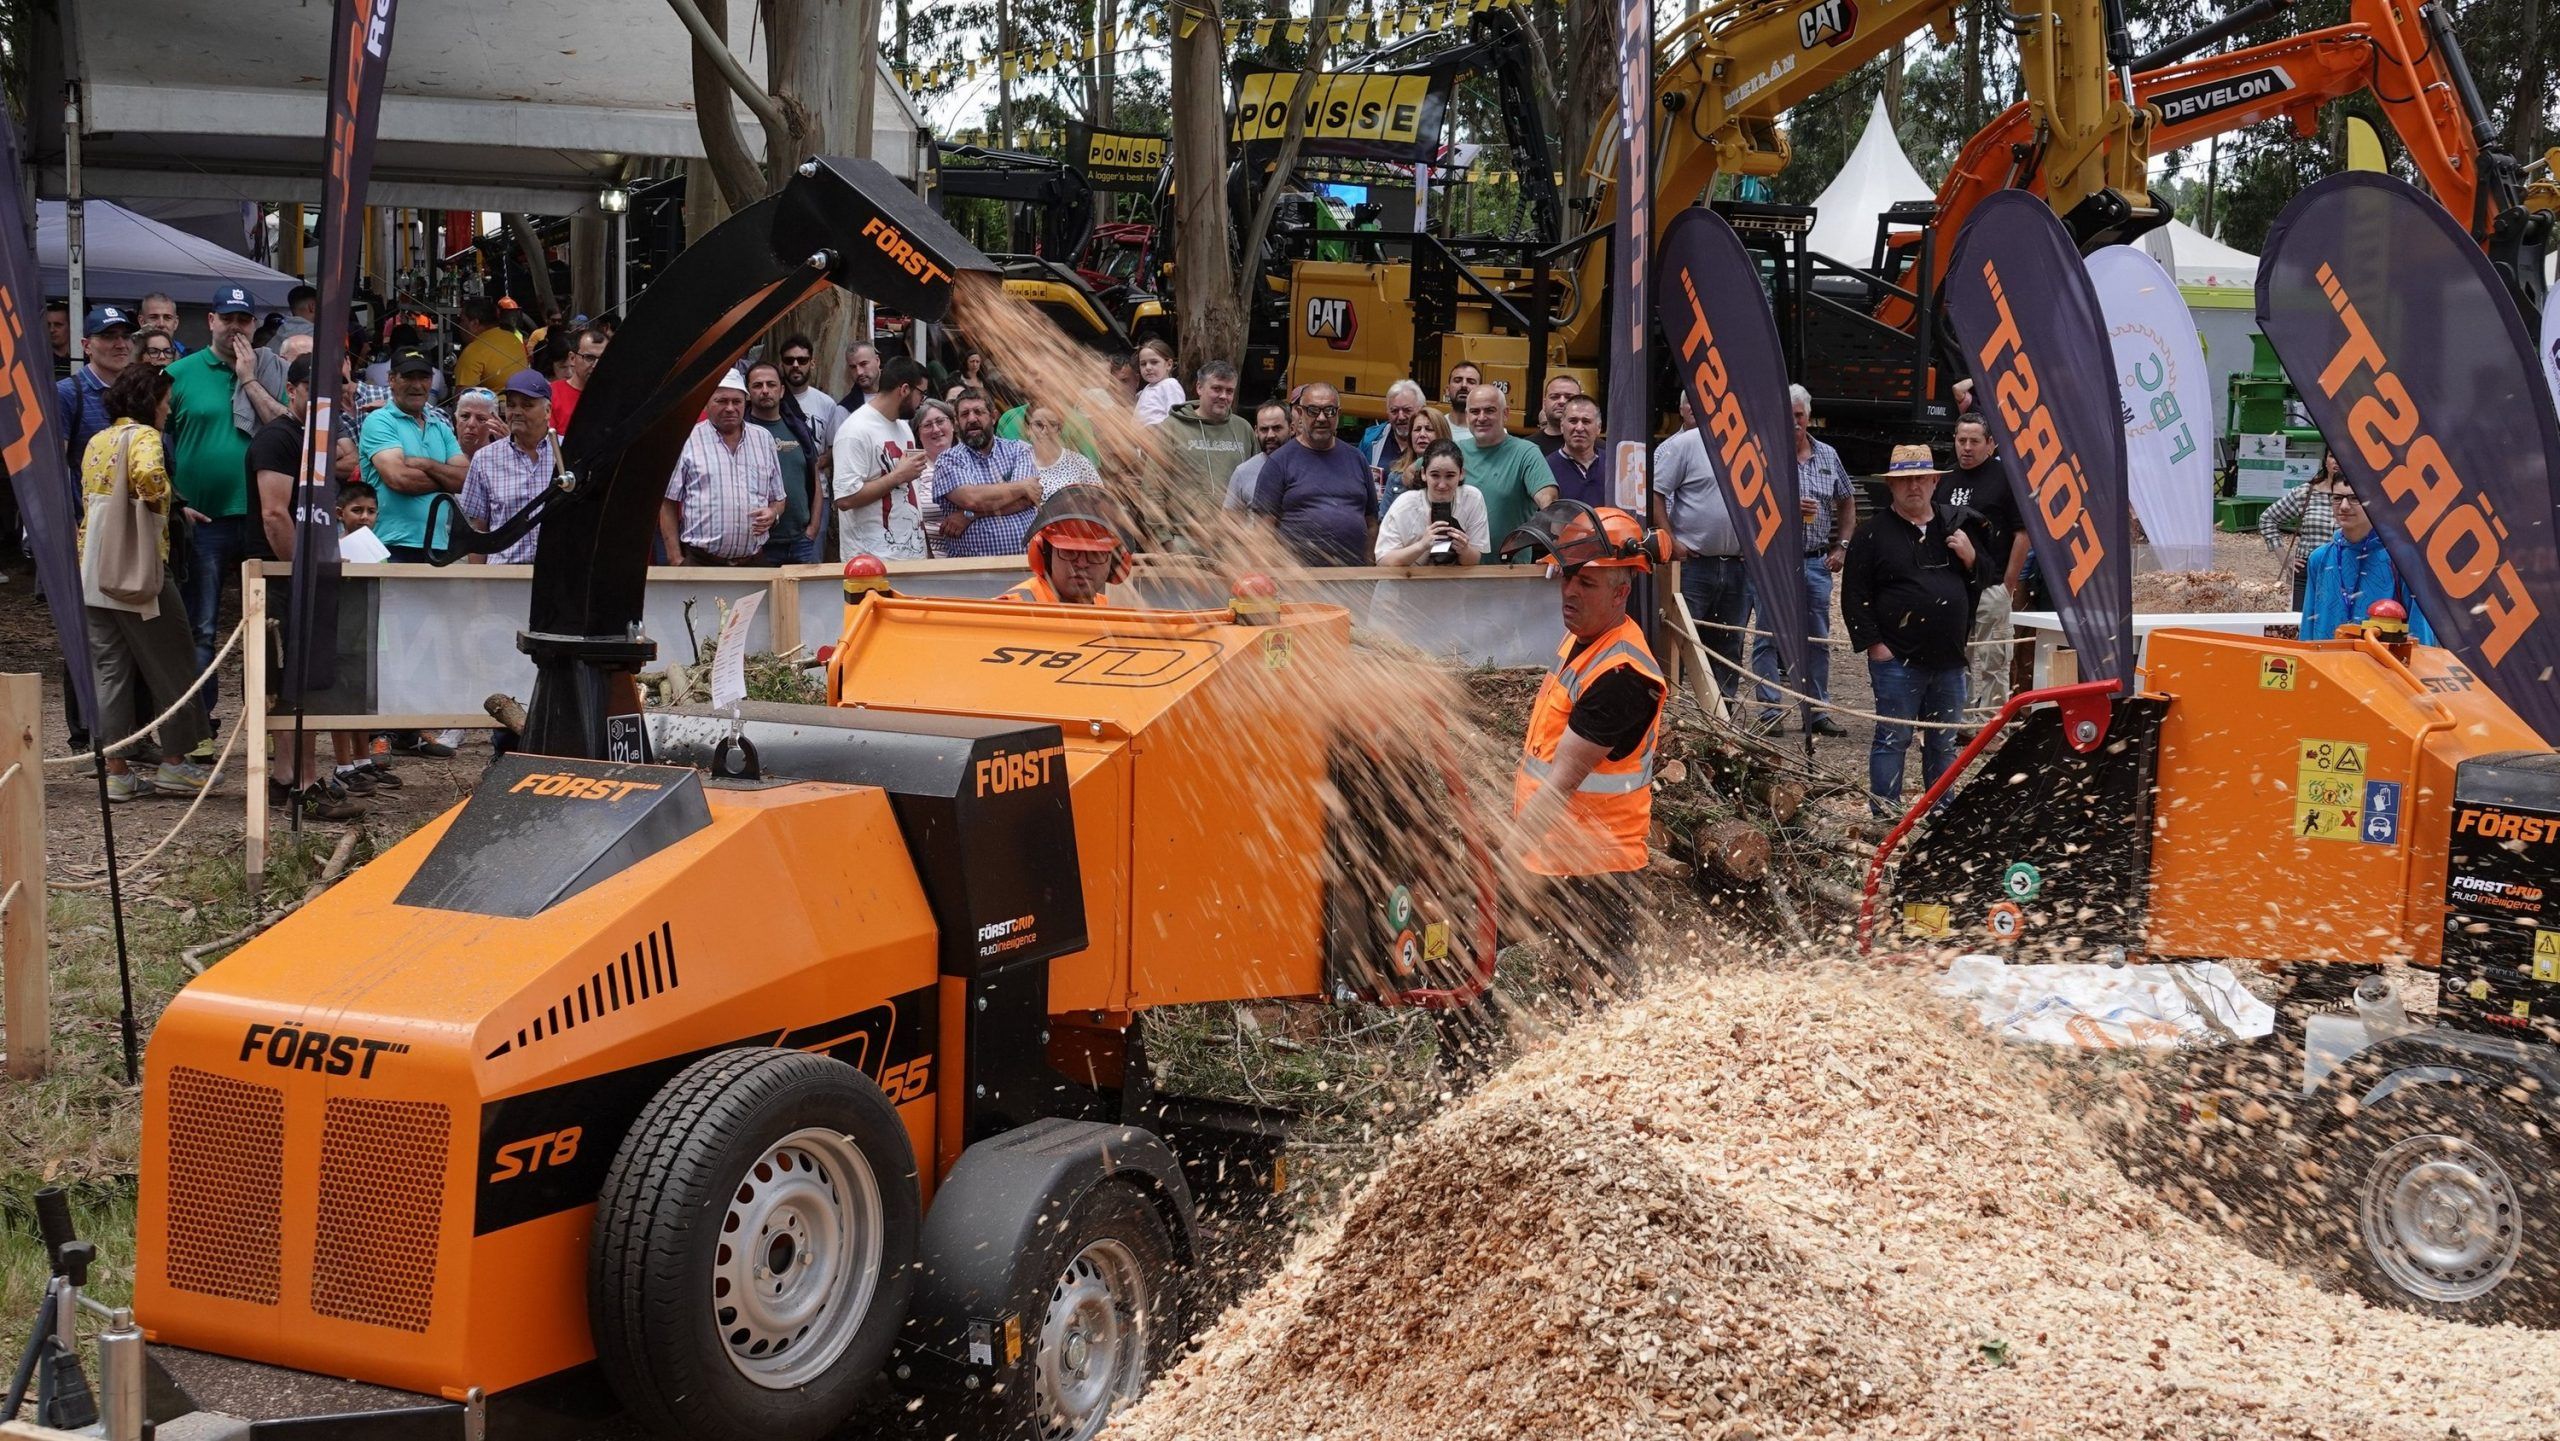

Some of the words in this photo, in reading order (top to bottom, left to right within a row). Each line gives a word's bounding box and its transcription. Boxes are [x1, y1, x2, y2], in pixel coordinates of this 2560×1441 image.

[1799, 0, 1842, 49] CAT
[1724, 53, 1796, 110] MEILÁN
[2164, 76, 2271, 119] DEVELON
[1087, 171, 1094, 179] A
[1095, 172, 1124, 182] logger's
[862, 217, 952, 285] FÖRST
[1003, 288, 1046, 298] ONSSE
[1308, 298, 1346, 338] CAT
[1926, 405, 1947, 416] TOIMIL
[980, 646, 1082, 669] ST8
[612, 740, 630, 763] 121
[630, 749, 640, 760] dB
[976, 745, 1064, 798] FÖRST
[508, 772, 662, 802] FÖRST
[2457, 807, 2560, 844] FÖRST
[239, 1021, 411, 1079] FÖRST
[489, 1126, 582, 1184] ST8
